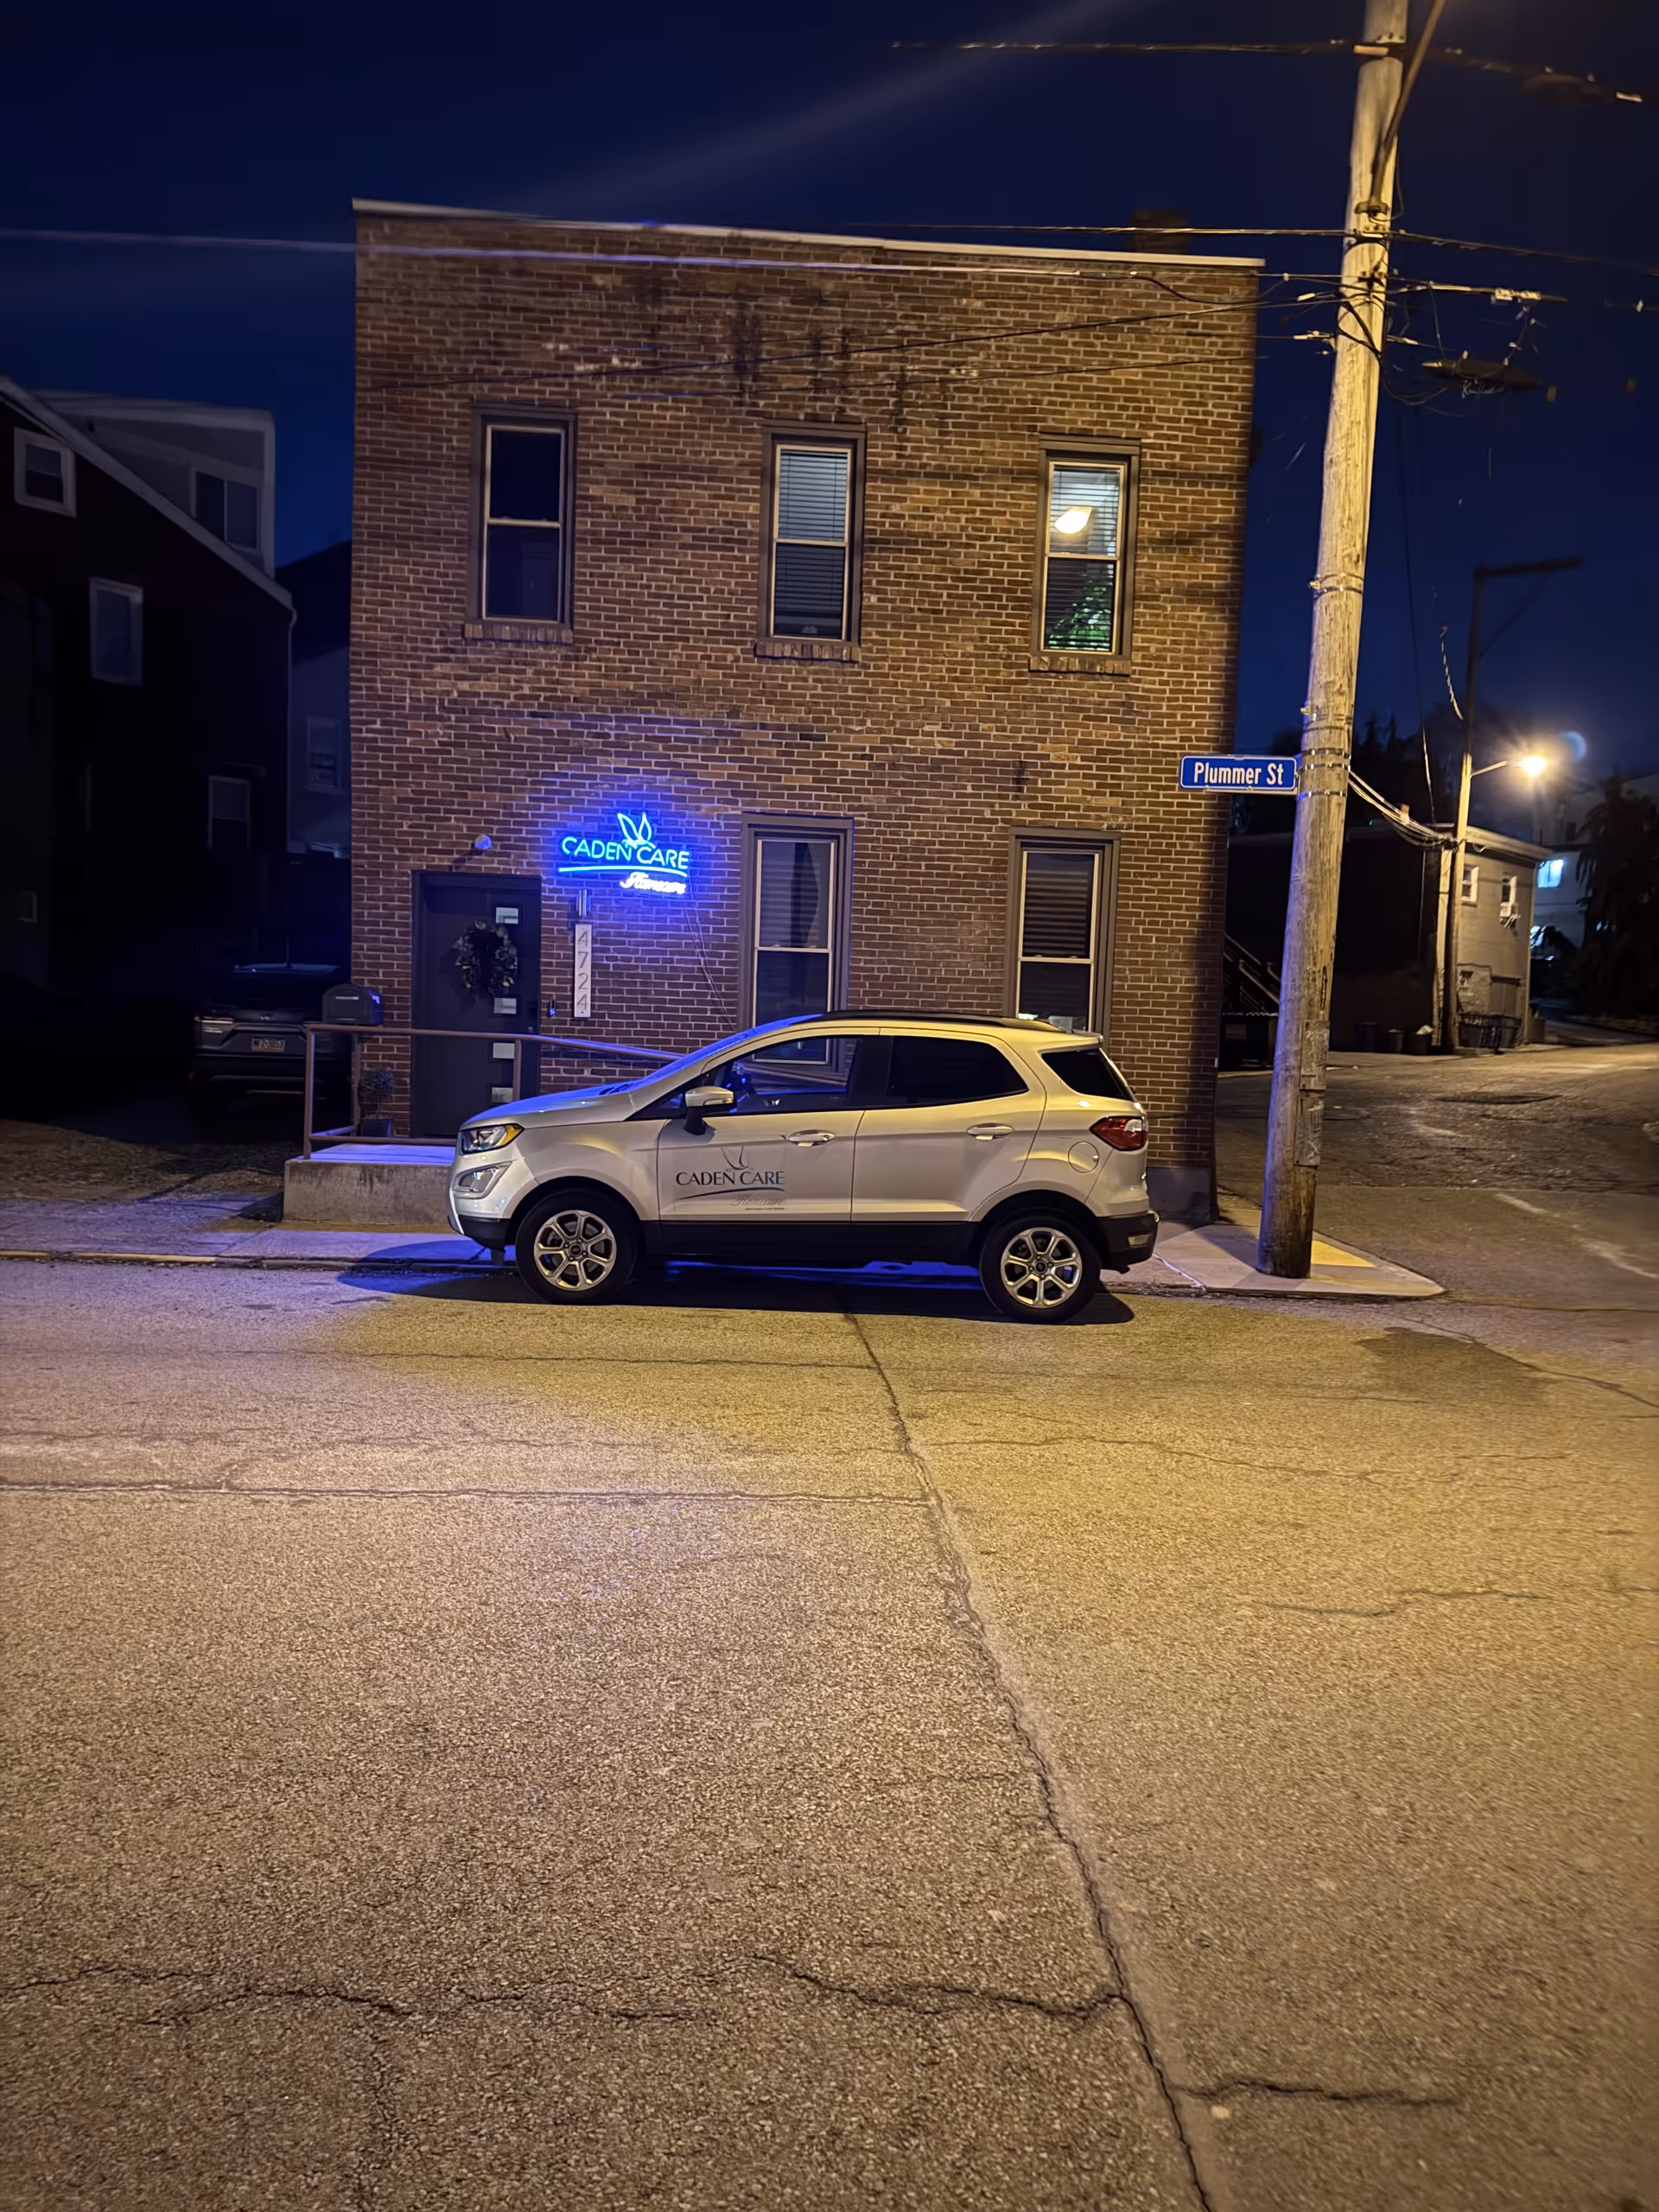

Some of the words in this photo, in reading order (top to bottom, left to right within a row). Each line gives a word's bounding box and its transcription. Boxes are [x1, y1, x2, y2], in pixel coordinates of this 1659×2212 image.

[1193, 761, 1262, 785] Plummer
[1266, 762, 1284, 785] St
[562, 836, 632, 861] CADEN
[636, 846, 690, 870] CARE
[576, 931, 589, 1011] 4724
[676, 1171, 734, 1185] CADEN
[740, 1171, 785, 1185] CARE
